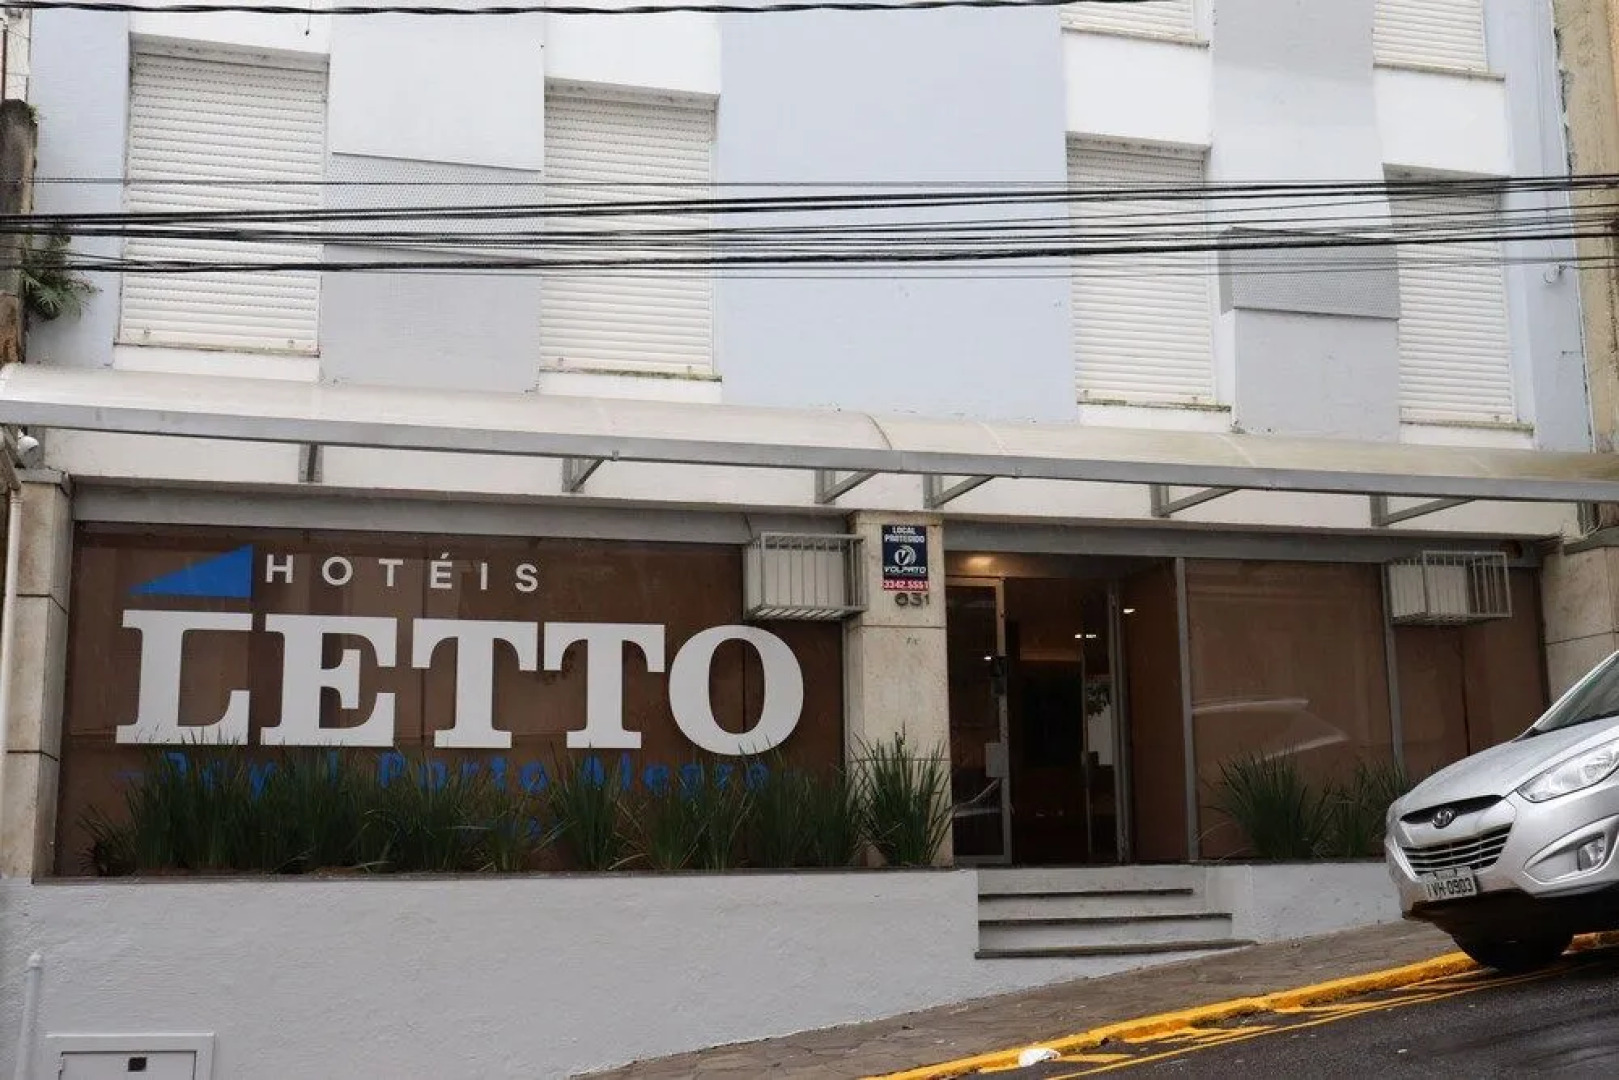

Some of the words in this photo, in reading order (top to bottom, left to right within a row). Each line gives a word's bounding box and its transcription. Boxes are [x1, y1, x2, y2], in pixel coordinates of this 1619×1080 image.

[892, 526, 916, 534] LOCAL
[265, 552, 539, 592] HOTÉIS
[116, 609, 804, 756] LETTO
